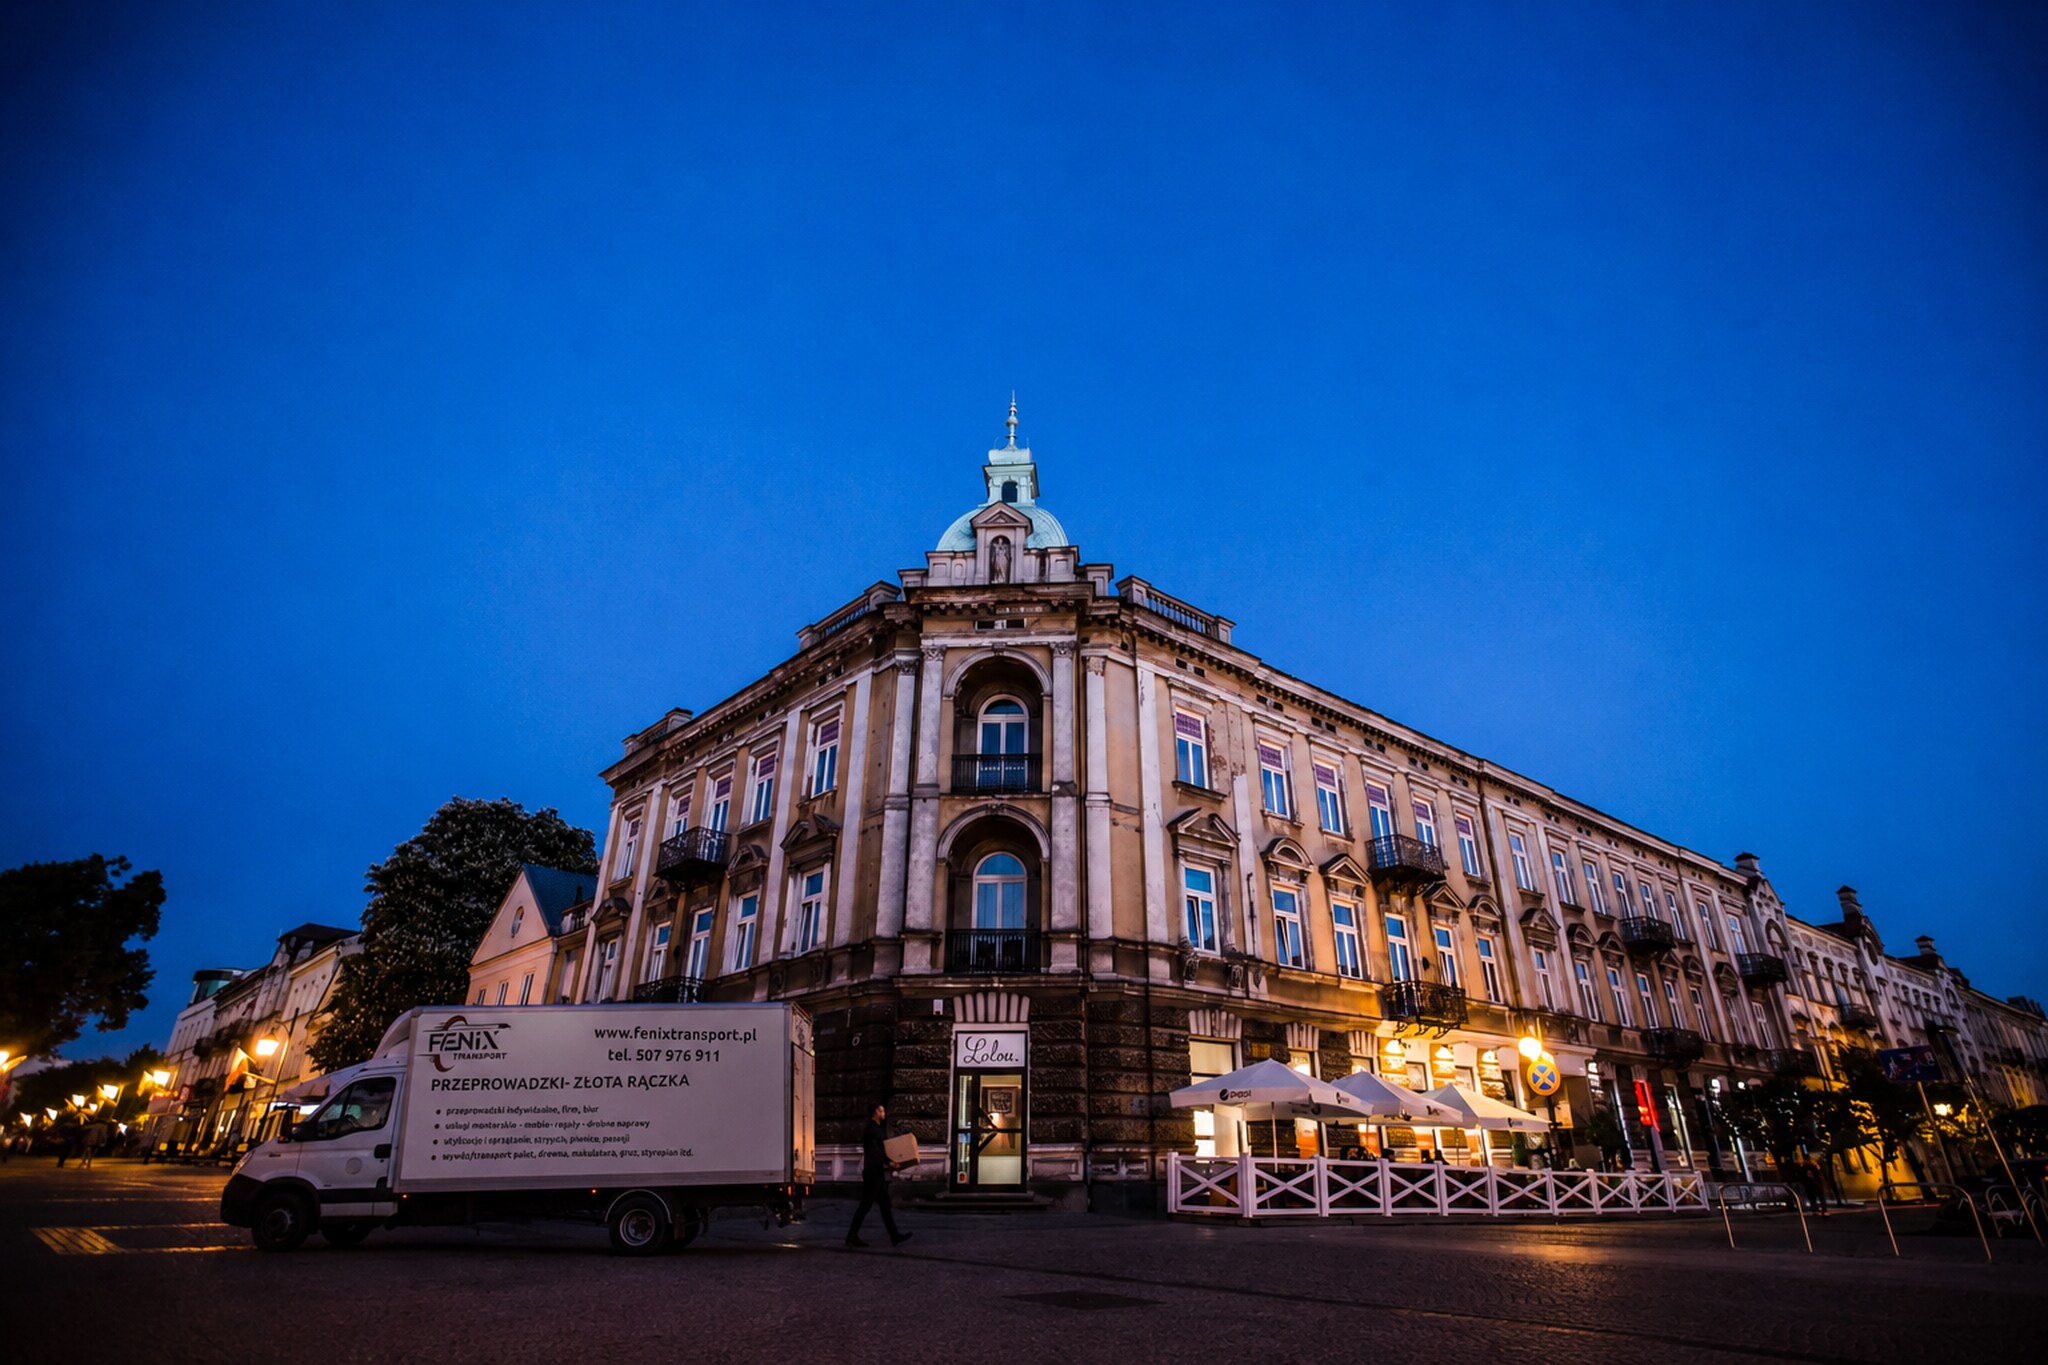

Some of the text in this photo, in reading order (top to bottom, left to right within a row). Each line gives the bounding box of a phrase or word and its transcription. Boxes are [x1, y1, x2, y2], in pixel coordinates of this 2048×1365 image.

[594, 1026, 757, 1044] www.fenixtransport.pl
[608, 1048, 720, 1062] tel. 507 976 911
[573, 1075, 623, 1089] ZŁOTA
[627, 1074, 690, 1091] RĄCZKA
